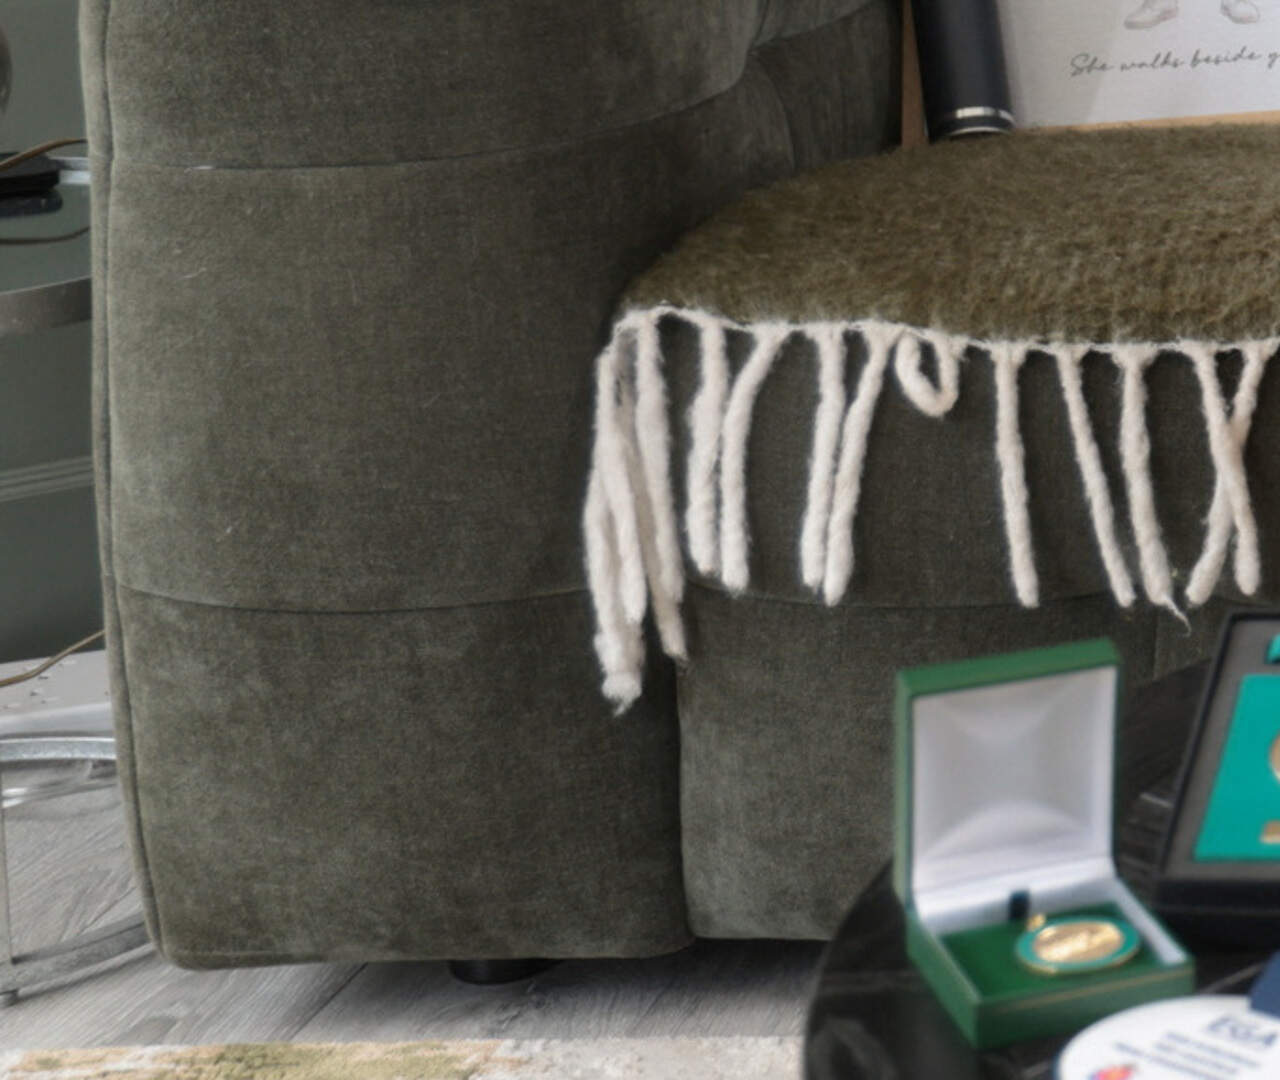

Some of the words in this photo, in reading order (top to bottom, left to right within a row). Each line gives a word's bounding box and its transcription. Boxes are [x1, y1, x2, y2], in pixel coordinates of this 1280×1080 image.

[1071, 51, 1114, 77] She
[1120, 51, 1183, 72] walks
[1190, 46, 1262, 69] beside
